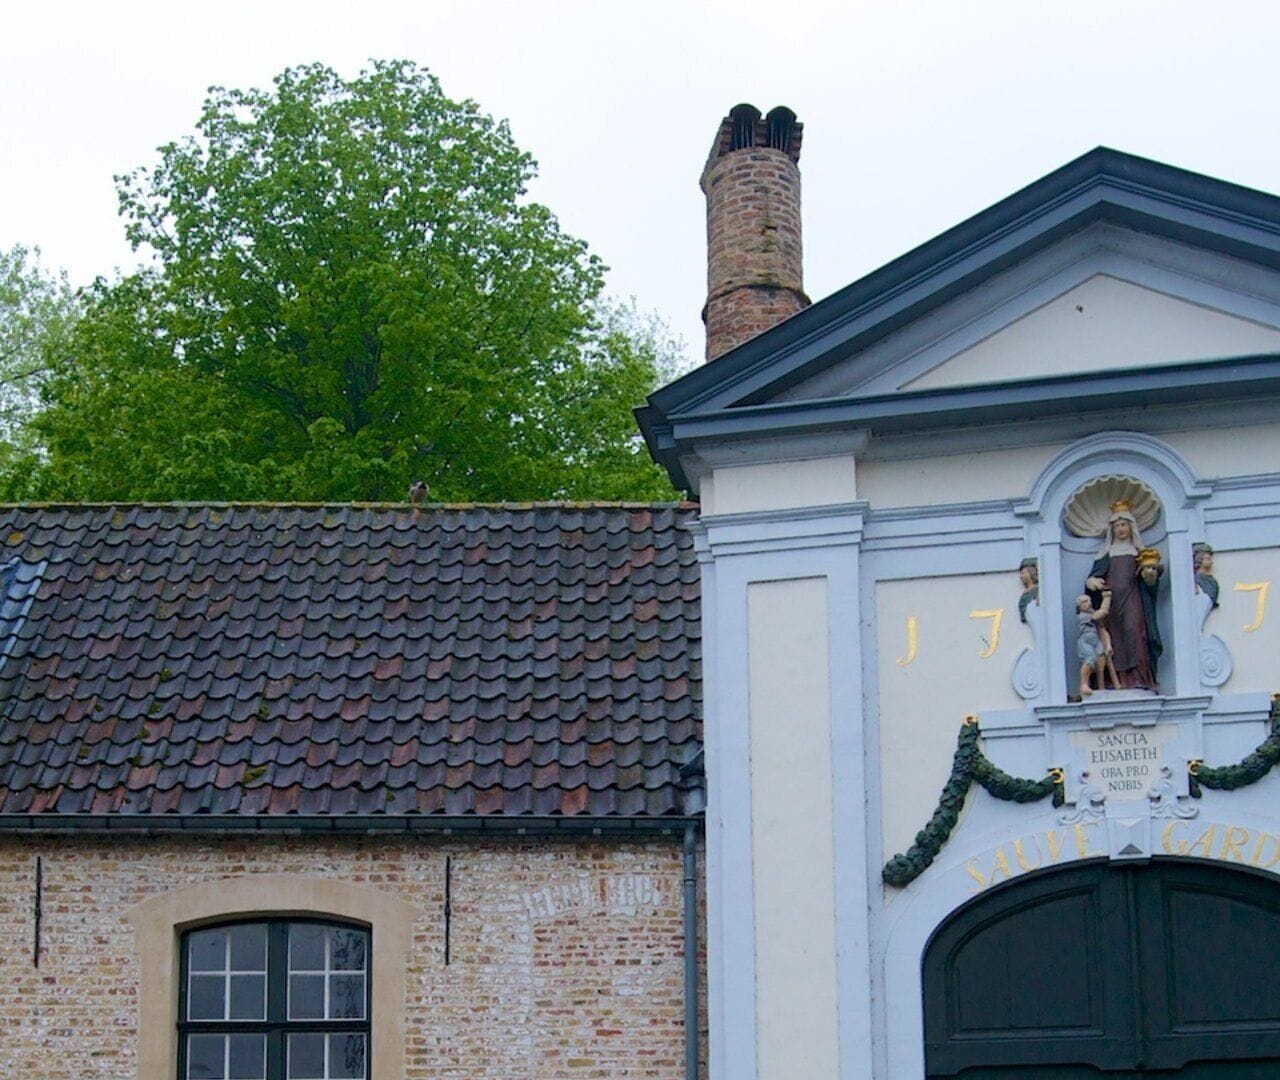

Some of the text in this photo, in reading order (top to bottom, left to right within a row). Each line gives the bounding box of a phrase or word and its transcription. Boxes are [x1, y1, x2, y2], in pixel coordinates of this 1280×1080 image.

[1098, 733, 1147, 747] SANCTA
[1091, 747, 1157, 763] ELISABETH
[1126, 764, 1149, 777] PRO
[1108, 779, 1143, 792] NOBIS
[966, 820, 1104, 893] SAUVE
